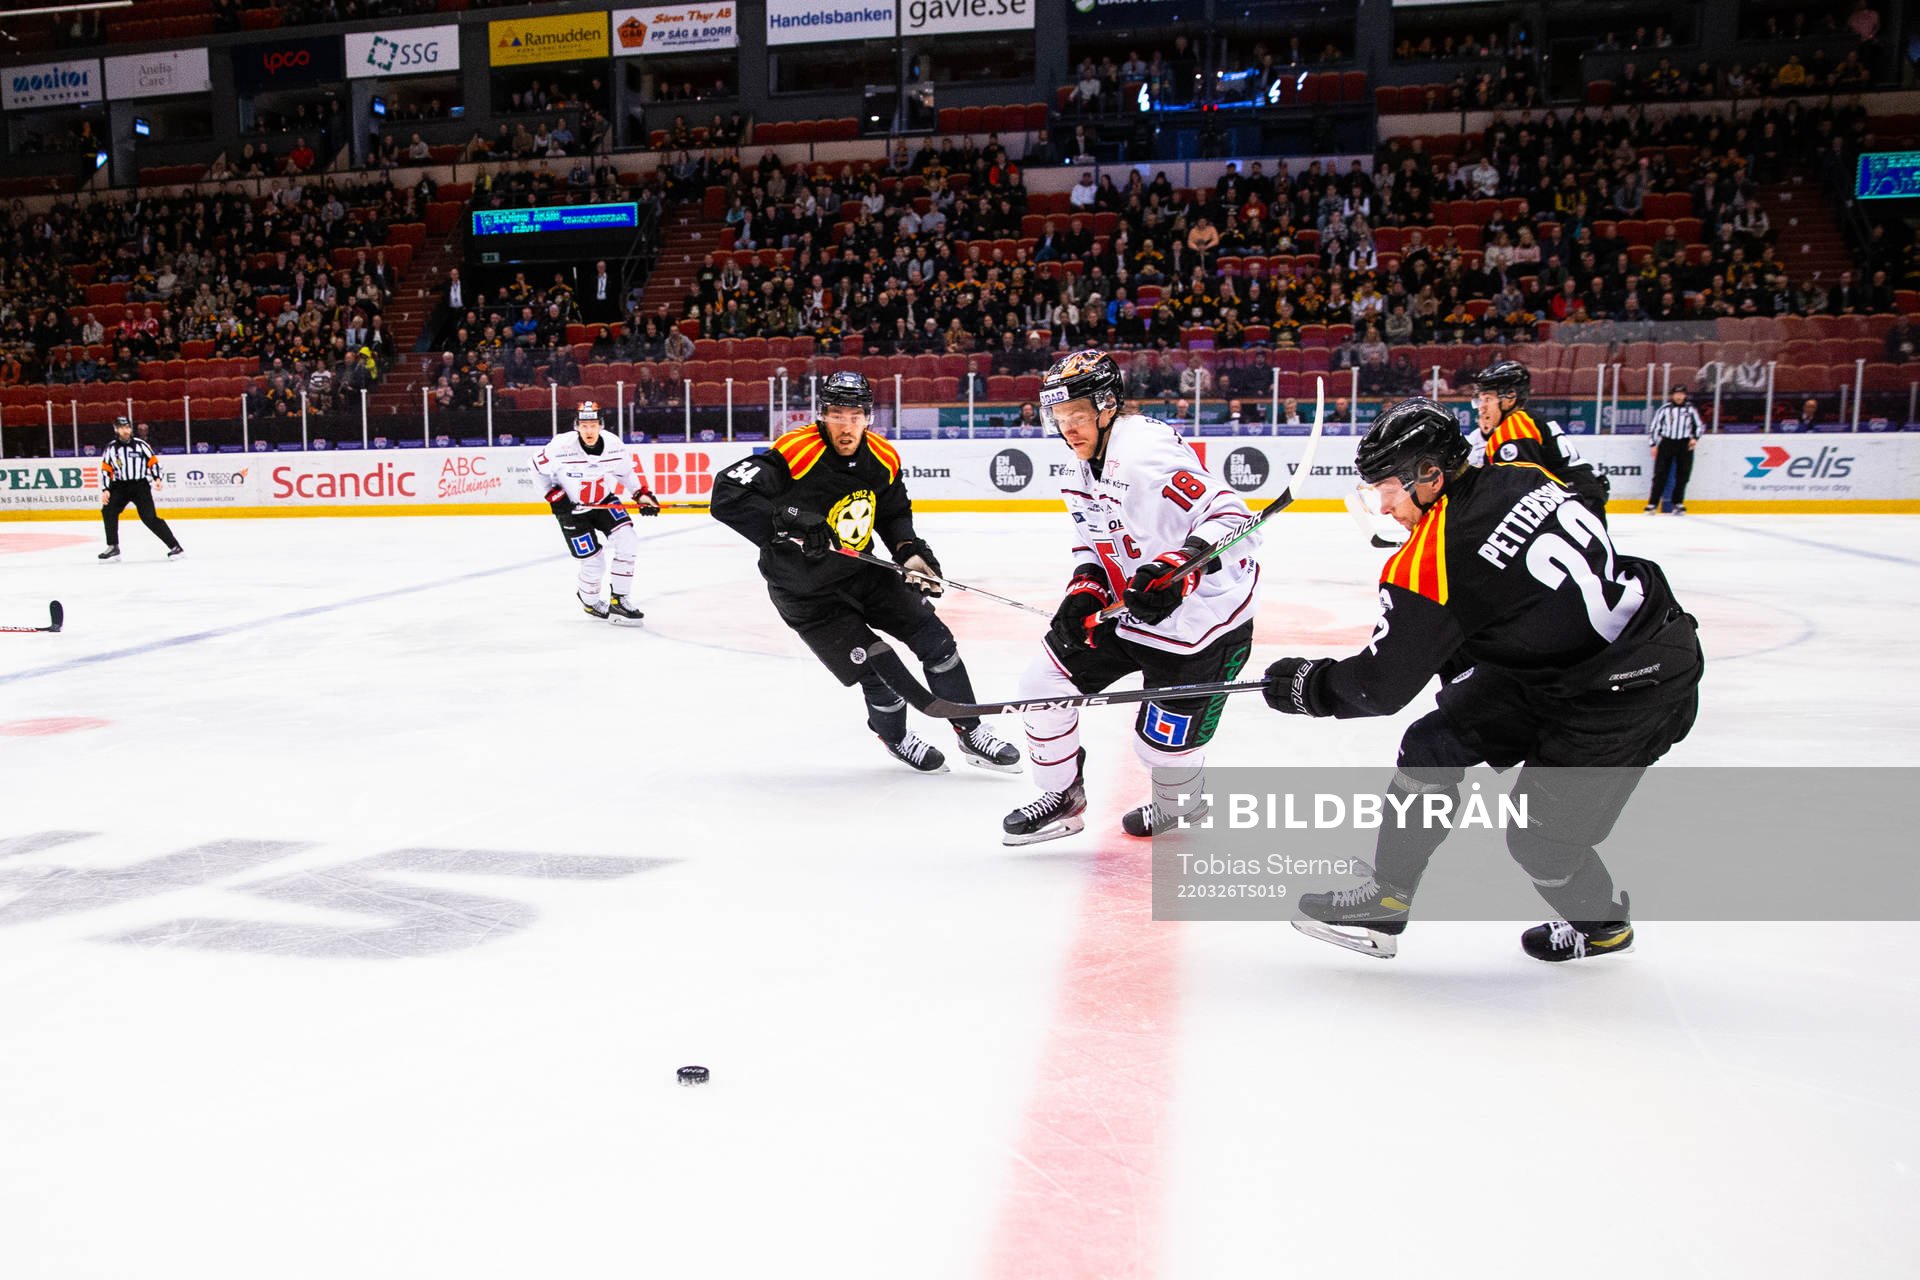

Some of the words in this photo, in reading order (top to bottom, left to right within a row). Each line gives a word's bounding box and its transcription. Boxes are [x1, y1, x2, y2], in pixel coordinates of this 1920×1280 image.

[769, 8, 893, 29] Handelsbanken
[525, 27, 601, 46] Ramudden
[702, 25, 732, 36] BORR
[400, 42, 439, 65] SSG
[13, 66, 89, 92] monitor
[441, 456, 487, 477] ABC
[996, 455, 1010, 466] EN
[1230, 454, 1245, 464] EN
[1786, 446, 1856, 478] elis
[614, 452, 713, 495] ABB
[726, 461, 762, 486] 34
[912, 466, 951, 478] barn
[996, 465, 1016, 476] BRA
[1230, 464, 1252, 475] BRA
[1598, 463, 1643, 476] barn
[272, 462, 417, 499] Scandic
[437, 477, 502, 498] Ställningar
[996, 475, 1028, 487] START
[1230, 474, 1263, 485] START
[15, 494, 100, 504] SAMHÄLLSBYGGARE
[851, 489, 869, 501] 1912
[1161, 470, 1207, 513] 18
[1122, 534, 1142, 560] C
[1525, 499, 1645, 644] 22
[1000, 696, 1110, 715] NEXUS
